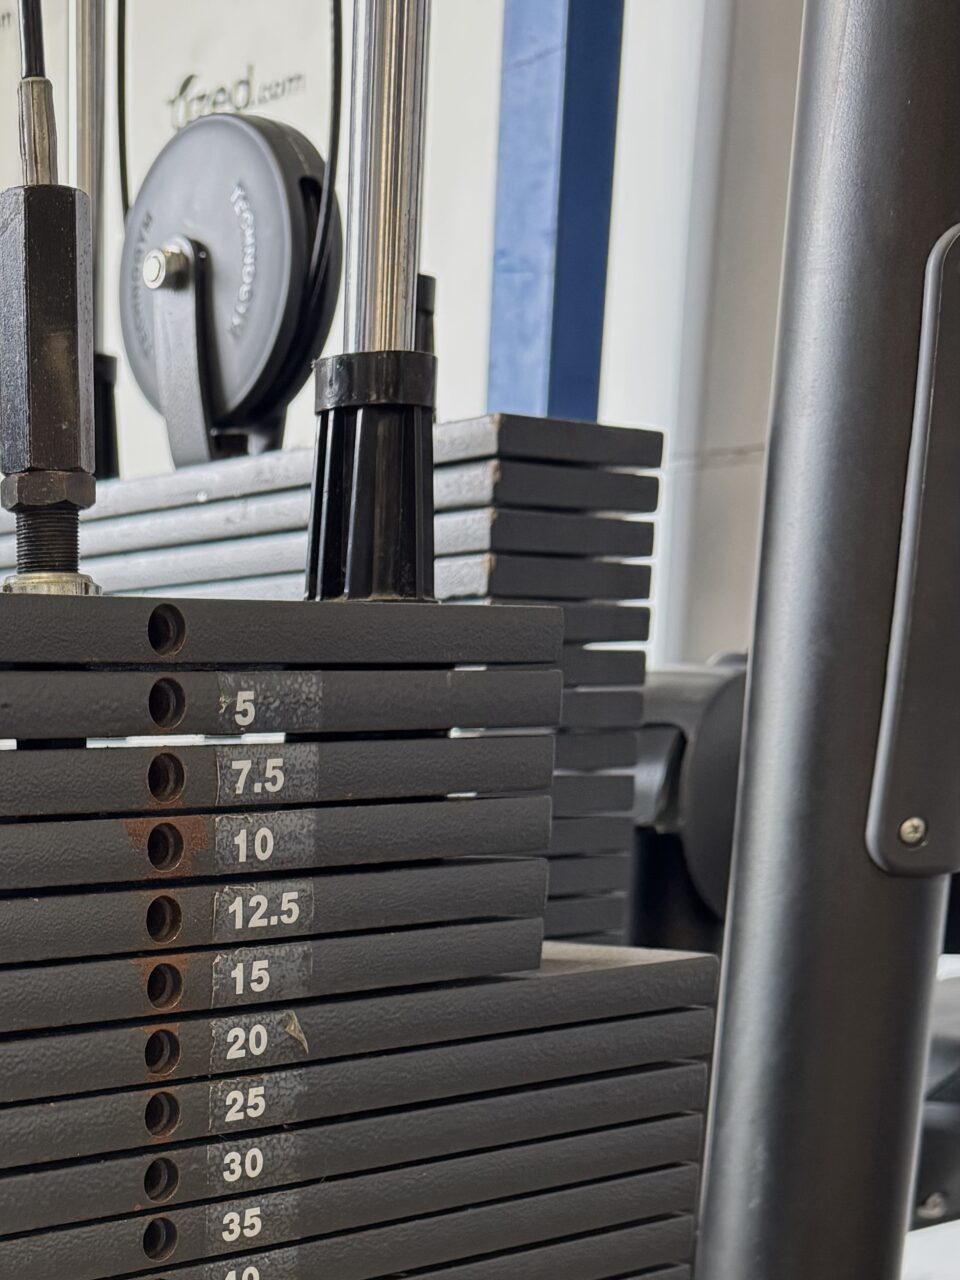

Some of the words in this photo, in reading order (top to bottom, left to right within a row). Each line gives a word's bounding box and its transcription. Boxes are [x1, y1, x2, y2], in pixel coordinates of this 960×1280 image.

[234, 691, 255, 726] 5
[231, 758, 285, 794] 7.5
[234, 827, 274, 862] 10
[228, 892, 299, 929] 12.5
[230, 960, 270, 995] 15
[226, 1024, 268, 1060] 20
[225, 1086, 266, 1122] 25
[223, 1147, 263, 1182] 30
[222, 1206, 262, 1242] 35
